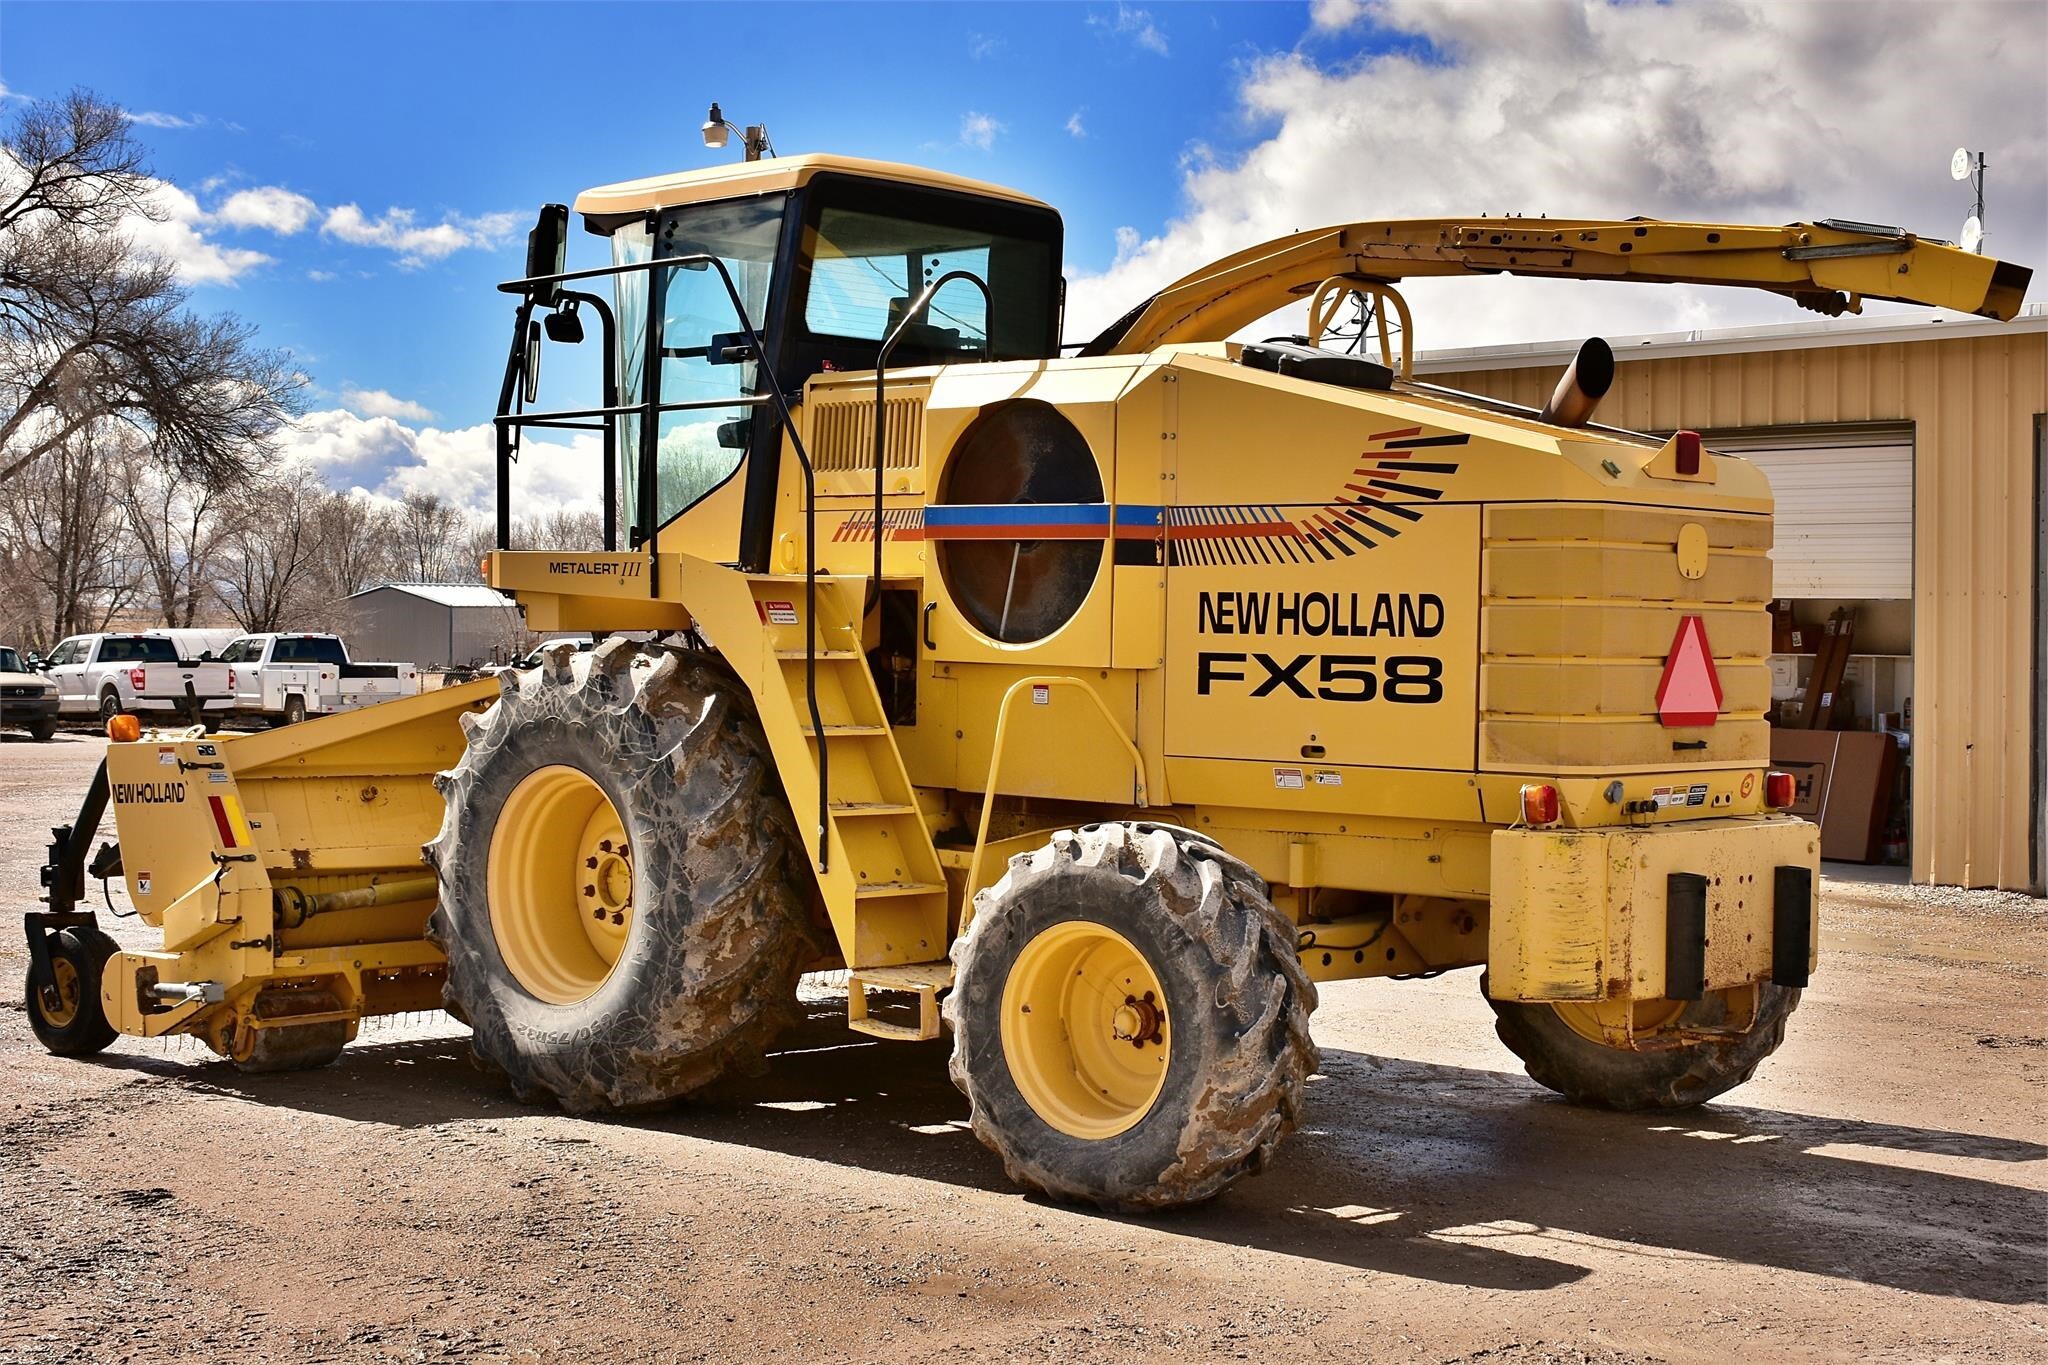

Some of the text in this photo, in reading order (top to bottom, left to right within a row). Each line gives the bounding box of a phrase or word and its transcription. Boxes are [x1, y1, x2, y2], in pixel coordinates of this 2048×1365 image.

[550, 561, 642, 576] METALERT III
[1198, 591, 1445, 638] NEW HOLLAND
[1197, 651, 1443, 704] FX58
[112, 782, 185, 803] NEW HOLLAND
